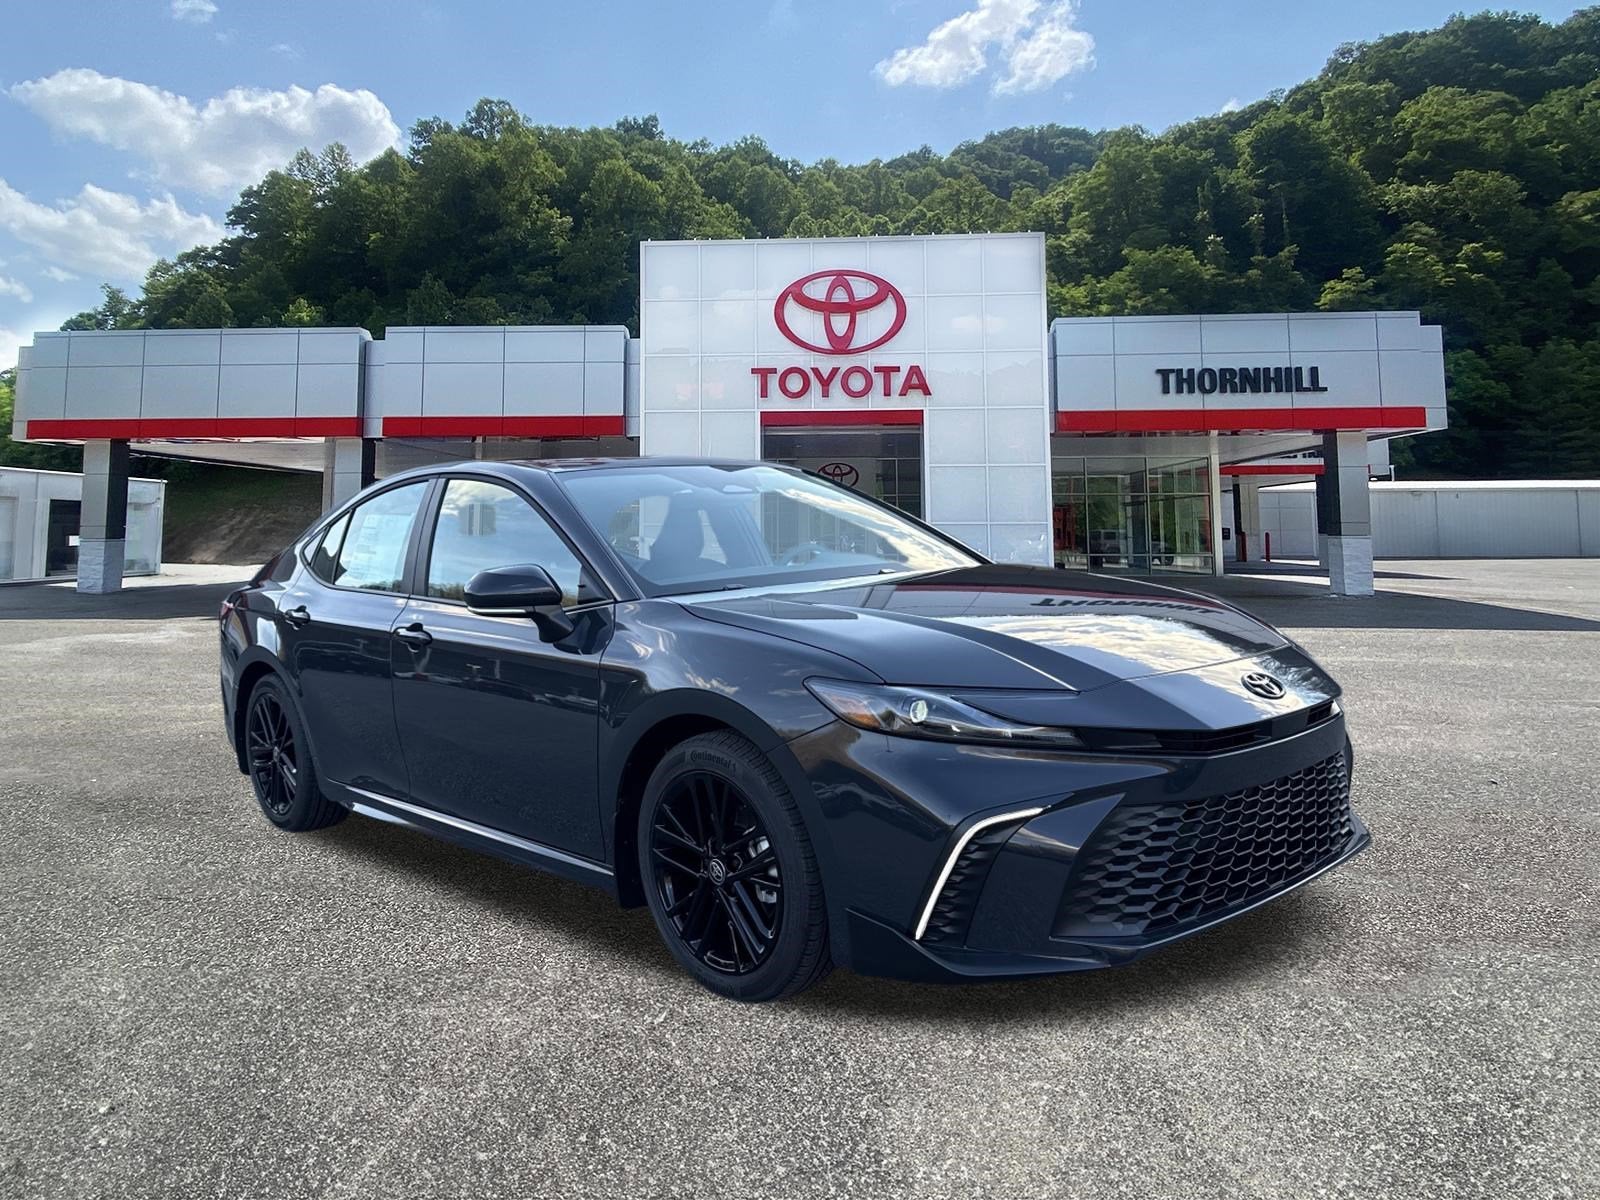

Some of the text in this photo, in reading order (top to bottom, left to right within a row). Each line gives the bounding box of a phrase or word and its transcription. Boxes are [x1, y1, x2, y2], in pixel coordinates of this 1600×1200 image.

[751, 365, 932, 398] TOYOTA
[1155, 366, 1328, 394] THORNHILL
[690, 750, 731, 769] Continental
